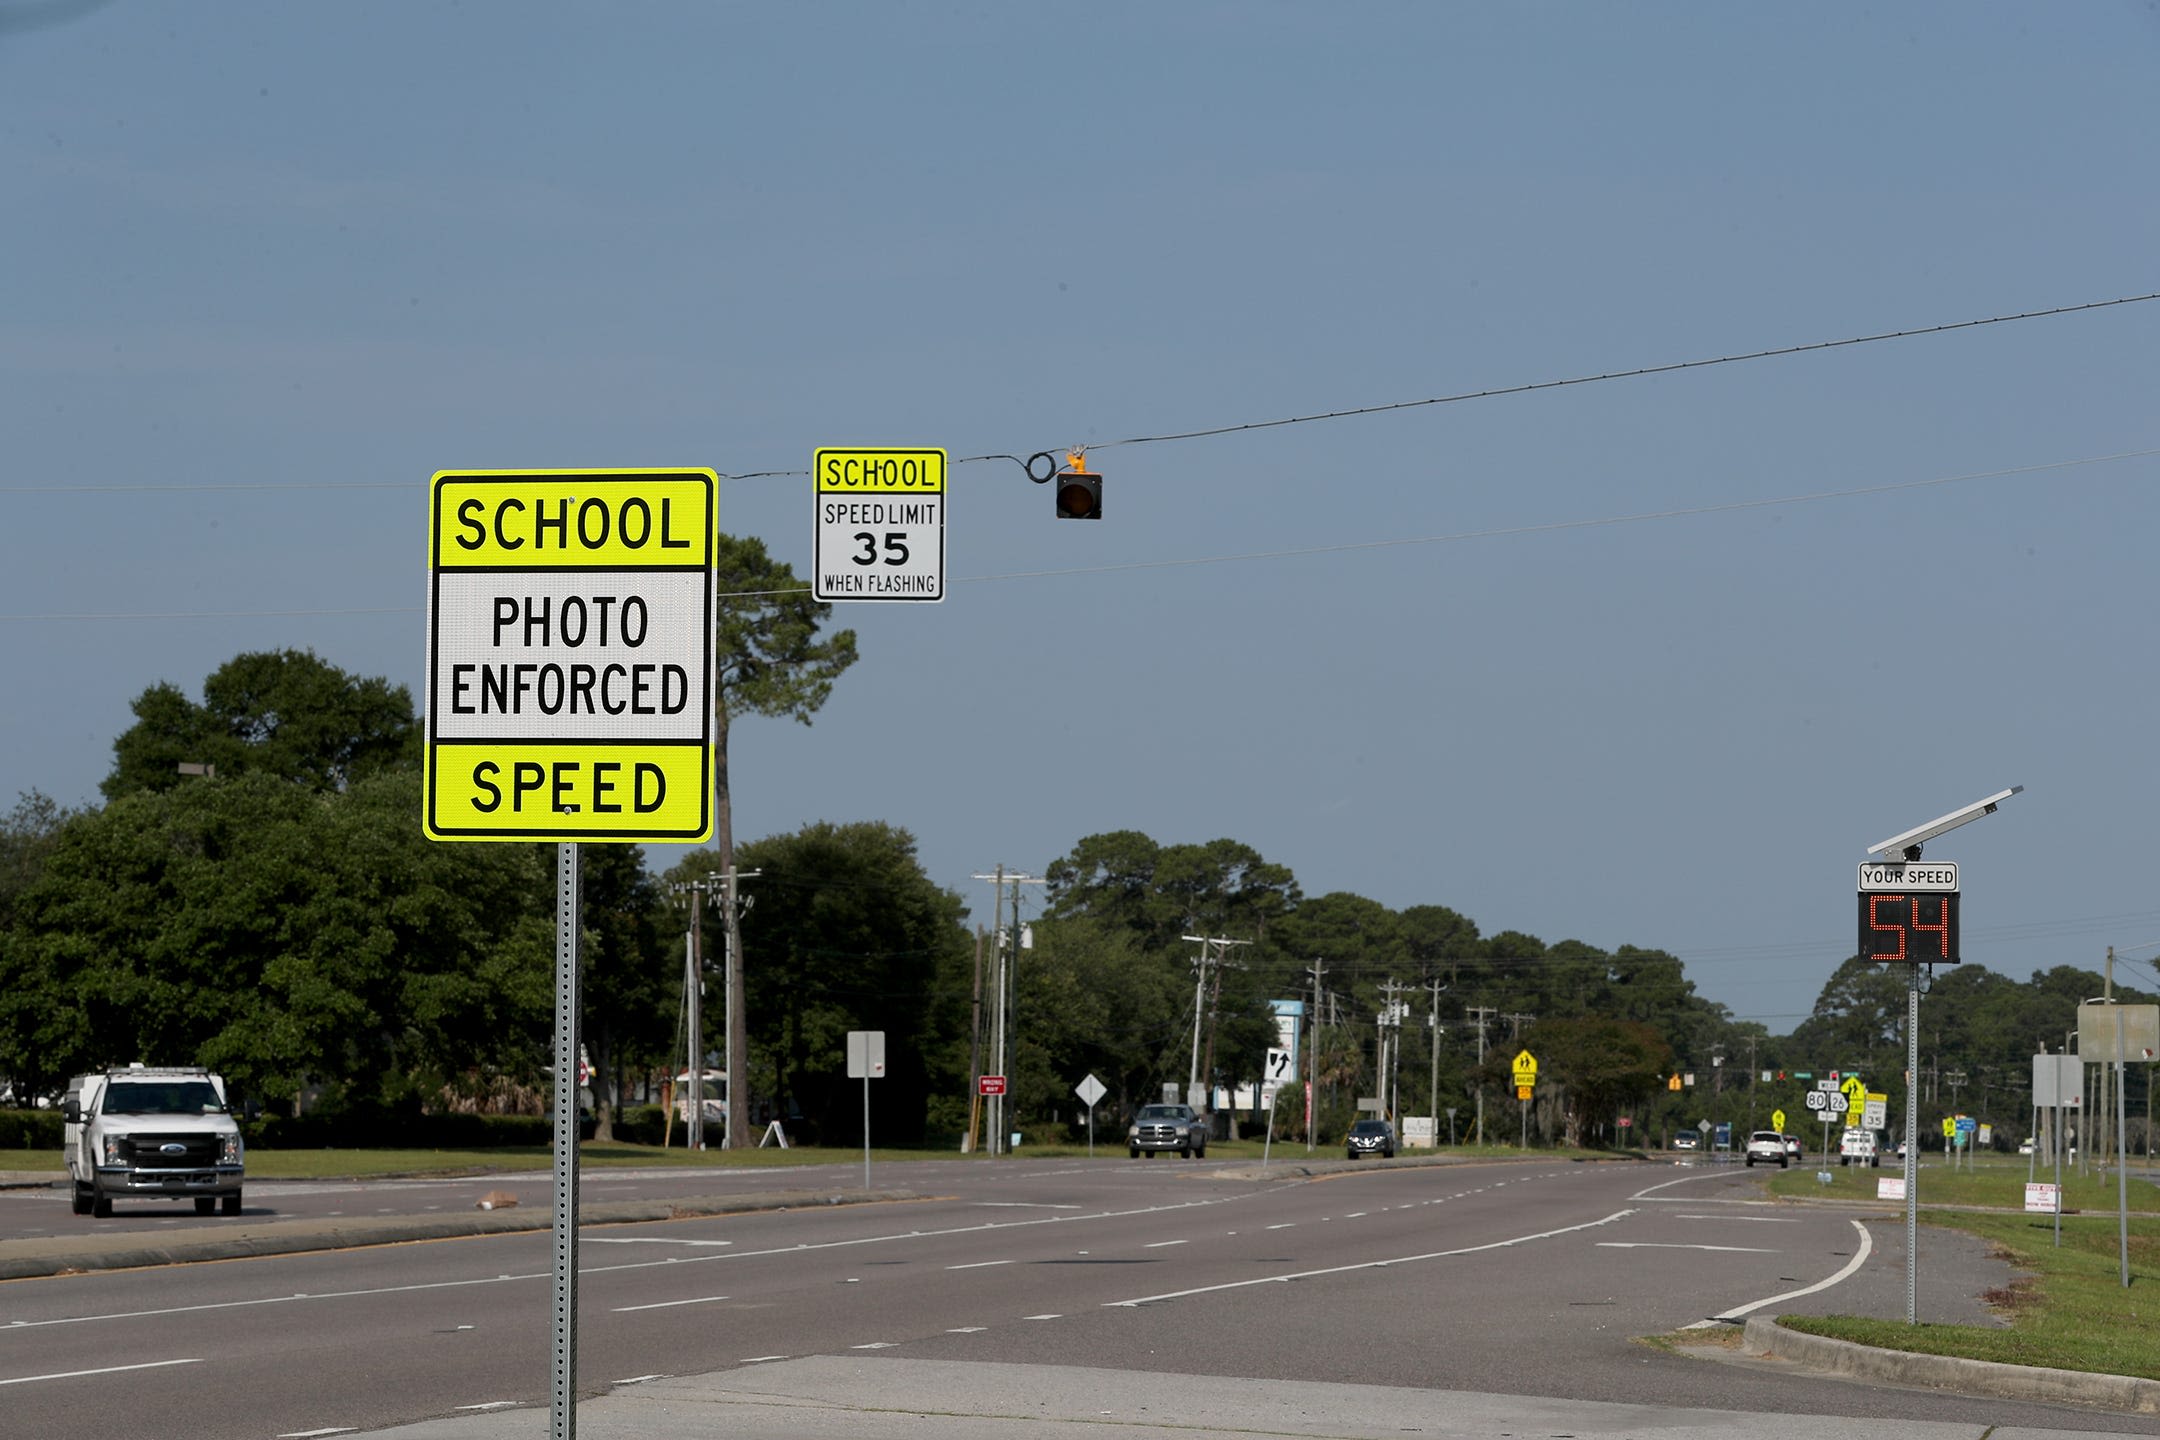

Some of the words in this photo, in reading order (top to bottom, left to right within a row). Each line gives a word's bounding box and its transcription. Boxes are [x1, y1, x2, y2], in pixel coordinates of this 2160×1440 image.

[826, 459, 935, 486] SCHOOL
[455, 497, 691, 551] SCHOOL
[825, 503, 884, 524] SPEED
[889, 504, 935, 524] LIMIT
[852, 532, 910, 566] 35
[824, 575, 863, 592] WHEN
[868, 575, 935, 592] FLASHING
[493, 595, 648, 648] PHOTO
[452, 663, 689, 715] ENFORCED
[471, 760, 667, 814] SPEED
[1863, 870, 1903, 884] YOUR
[1908, 870, 1954, 884] SPEED
[1870, 895, 1948, 960] 54
[1808, 1094, 1825, 1106] 80
[1832, 1097, 1845, 1109] 26
[1867, 1116, 1882, 1126] 35
